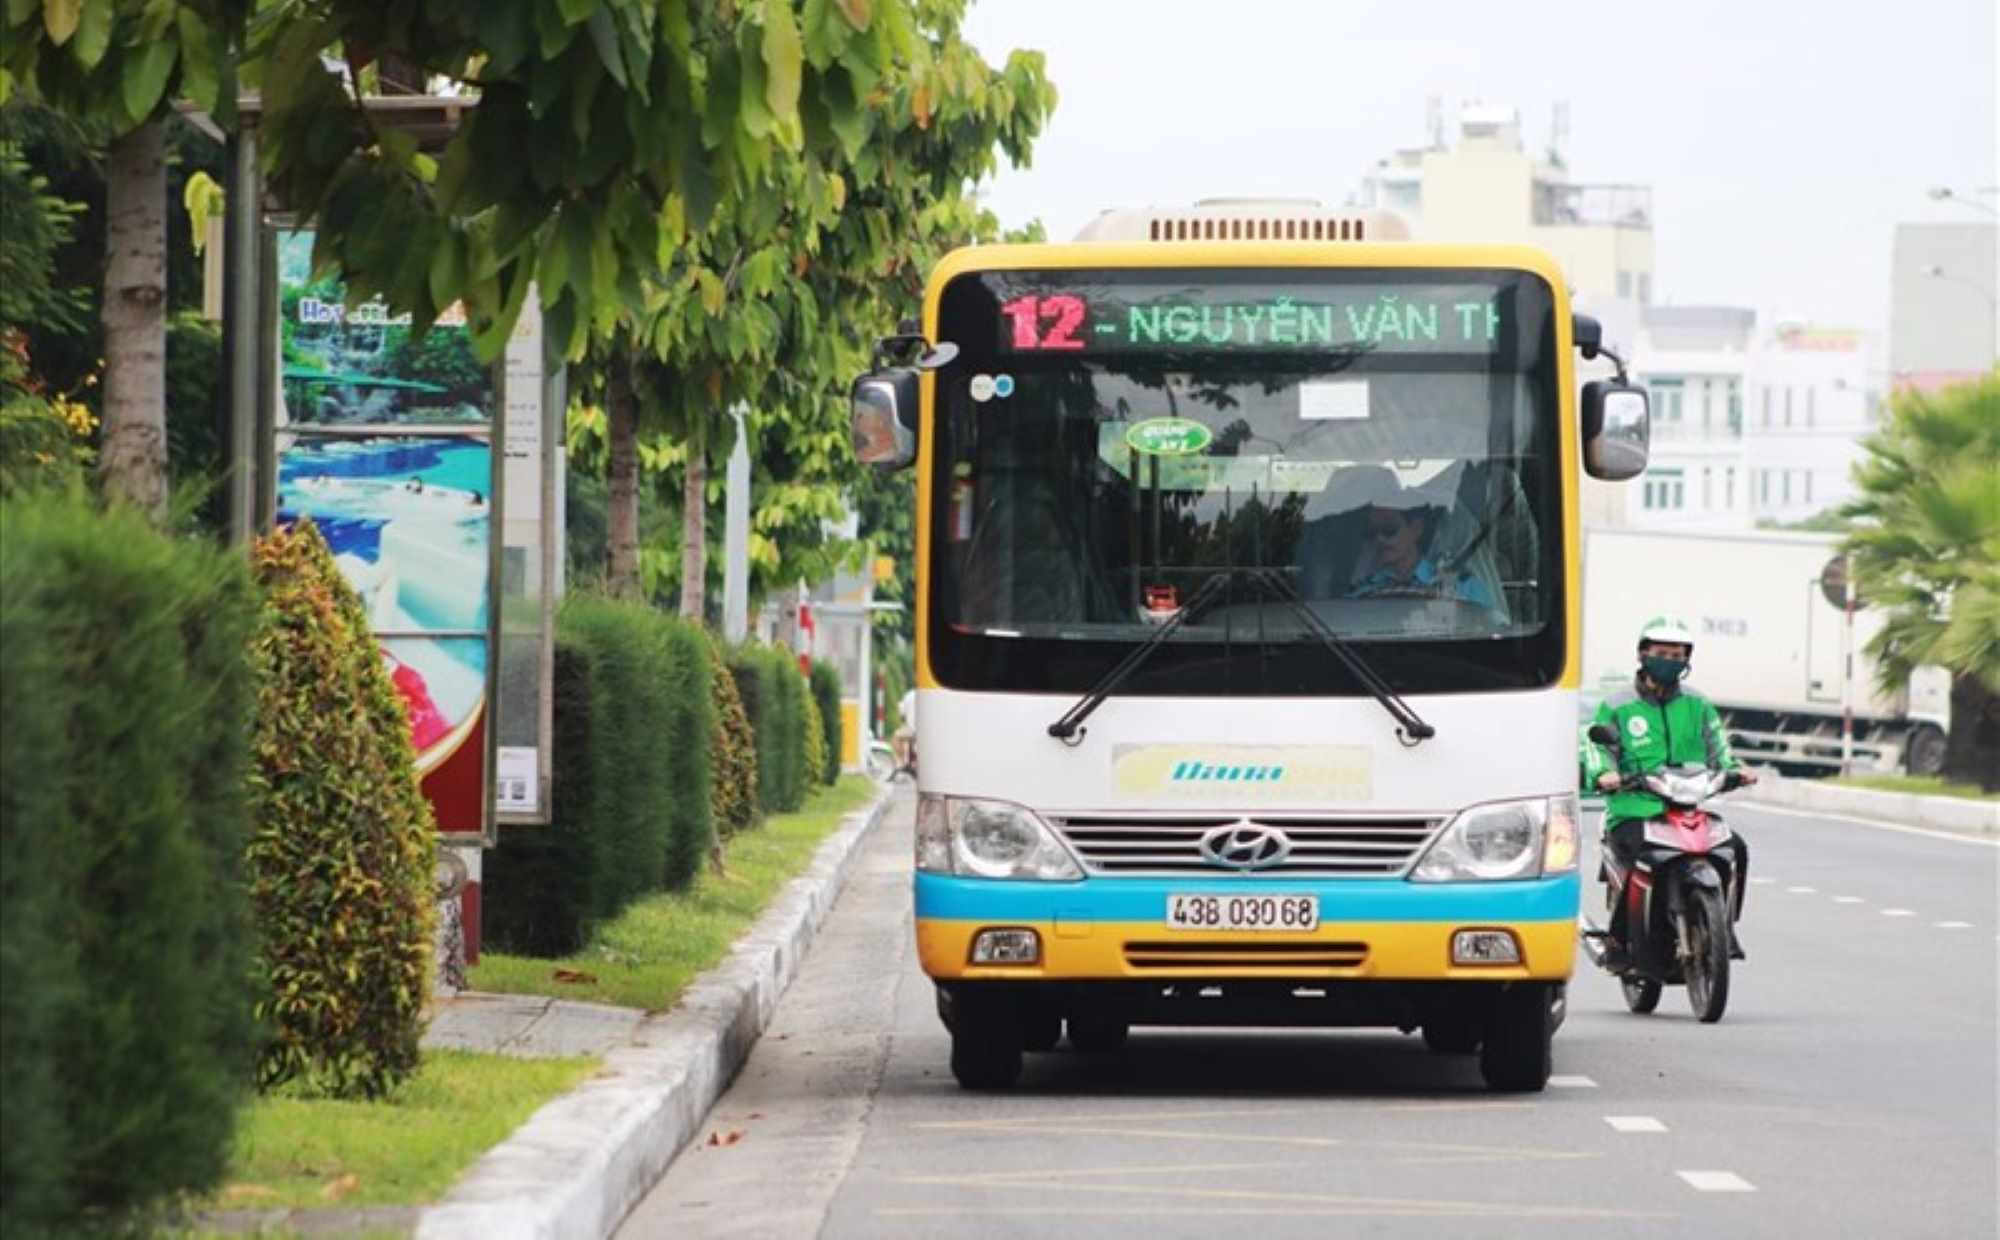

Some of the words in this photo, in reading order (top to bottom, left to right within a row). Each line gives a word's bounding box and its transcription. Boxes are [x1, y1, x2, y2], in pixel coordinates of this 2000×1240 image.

[1002, 294, 1086, 349] 12
[1129, 295, 1333, 343] NGUYỄN
[1345, 295, 1438, 342] VĂN
[1174, 897, 1220, 925] 43B
